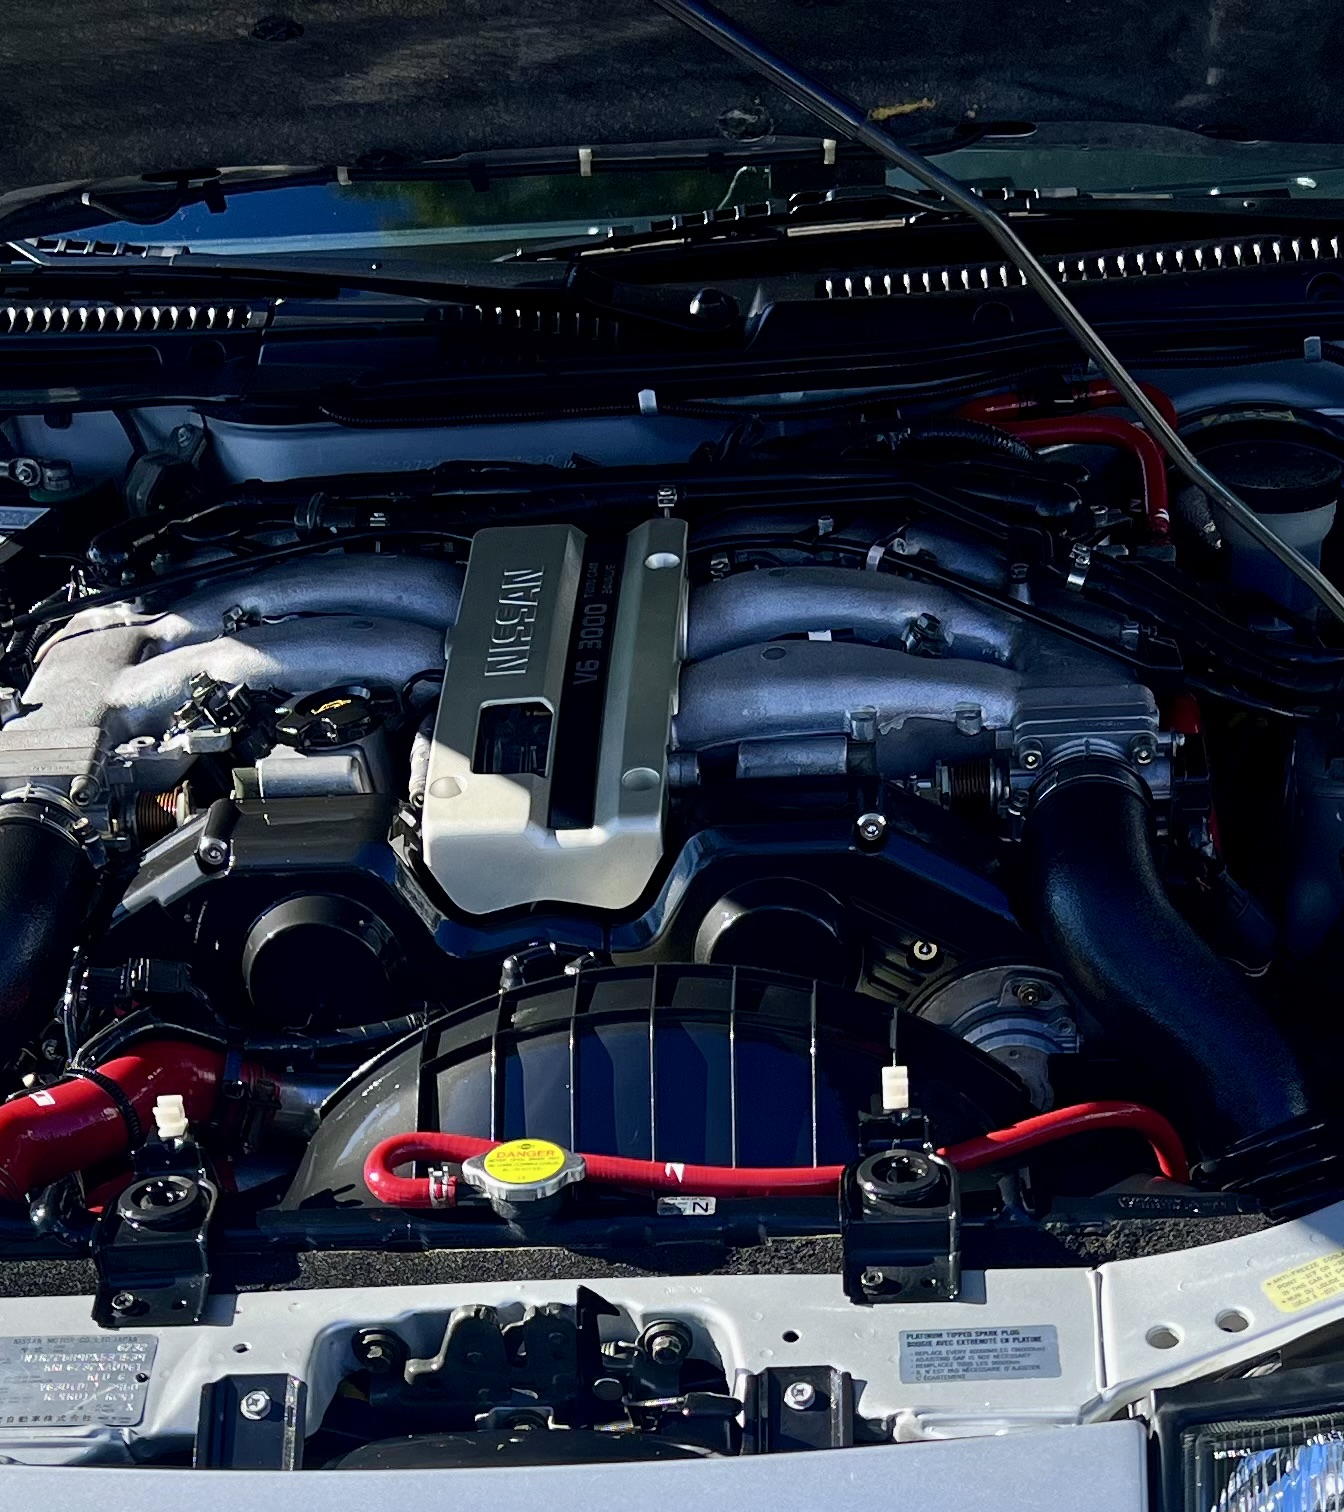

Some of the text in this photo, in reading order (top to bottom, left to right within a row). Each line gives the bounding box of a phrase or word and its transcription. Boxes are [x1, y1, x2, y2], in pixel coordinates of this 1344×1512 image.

[484, 566, 544, 677] NISSAN
[573, 603, 607, 685] V6 3000
[496, 1149, 556, 1159] DANGER
[1276, 1277, 1297, 1290] POINT
[1307, 1275, 1323, 1286] CAR
[946, 1331, 973, 1339] TIPPED
